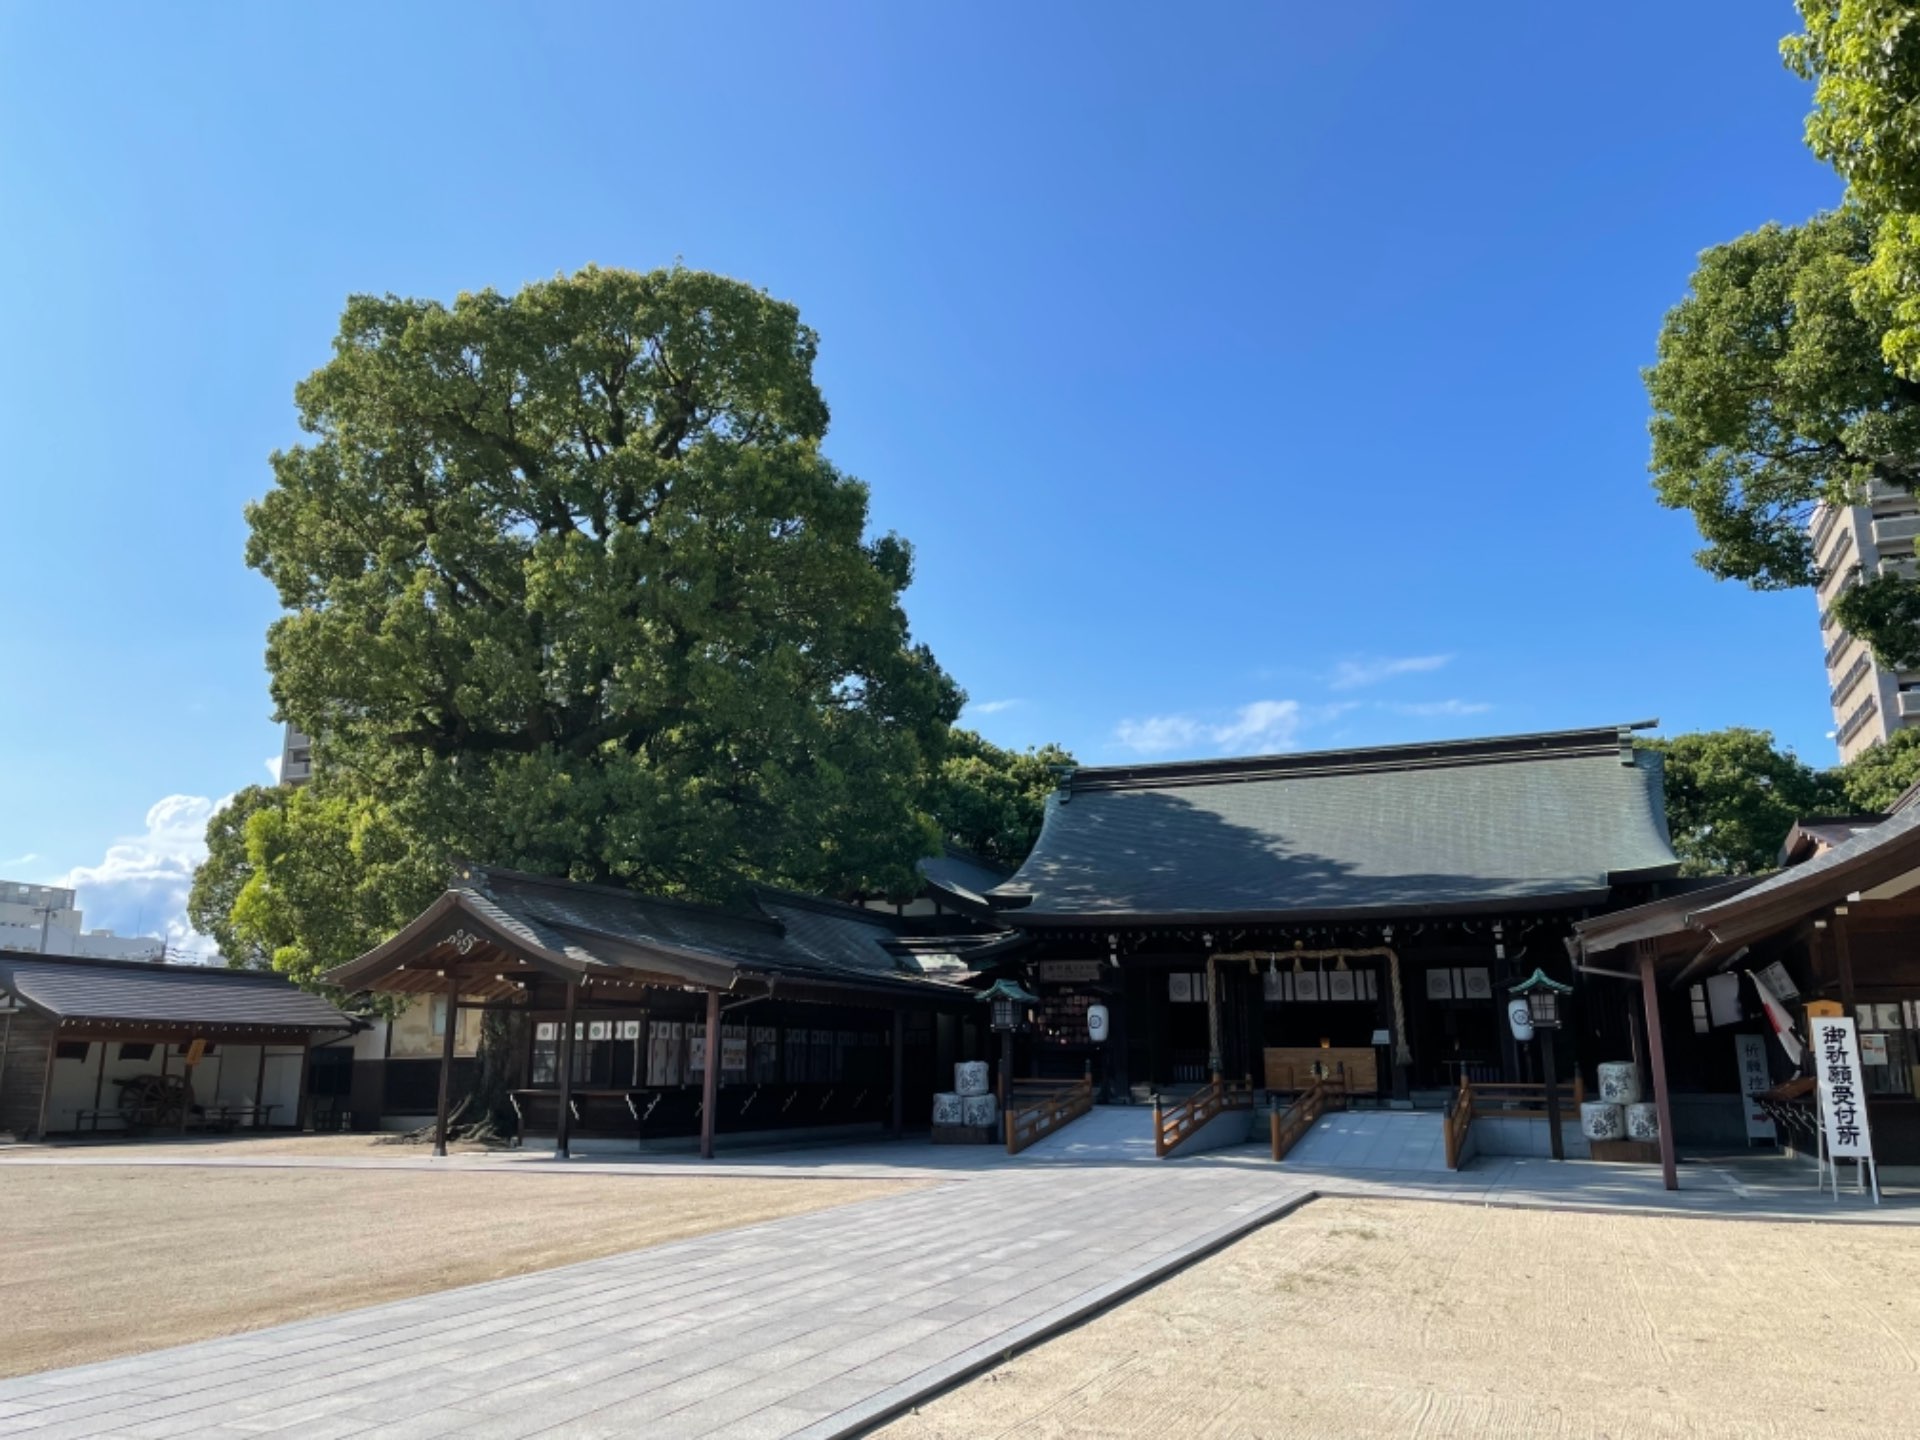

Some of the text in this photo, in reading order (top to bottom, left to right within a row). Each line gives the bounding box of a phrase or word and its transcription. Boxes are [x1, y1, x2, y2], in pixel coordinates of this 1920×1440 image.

[1744, 1042, 1766, 1105] 祈願控
[1822, 1025, 1860, 1147] 御祈願受付所
